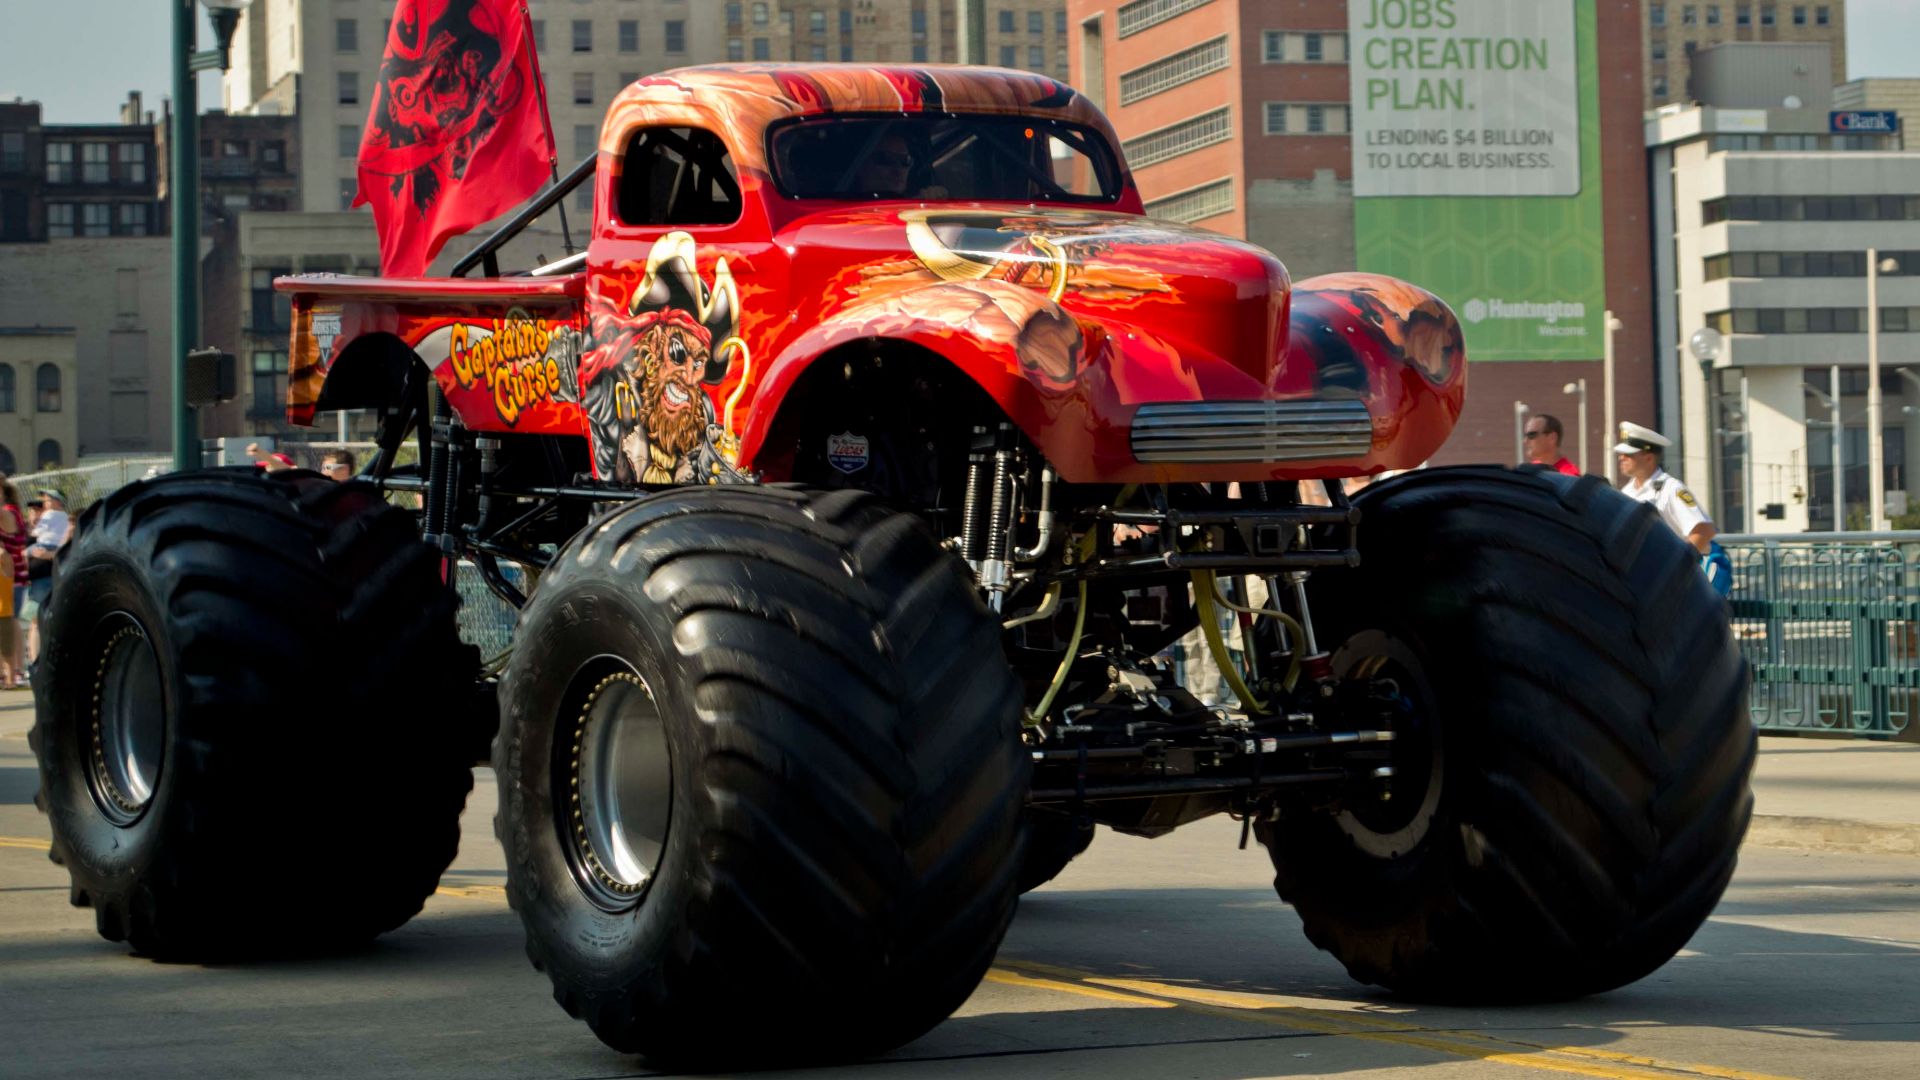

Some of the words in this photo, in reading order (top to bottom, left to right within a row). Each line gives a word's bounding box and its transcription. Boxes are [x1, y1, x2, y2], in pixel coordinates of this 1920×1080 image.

[1363, 0, 1457, 29] JOBS
[1364, 38, 1549, 70] CREATION
[1366, 78, 1476, 111] PLAN.
[1366, 129, 1448, 146] LENDING
[1454, 129, 1476, 147] $4
[1484, 129, 1554, 146] BILLION
[1368, 152, 1391, 169] TO
[1397, 152, 1454, 169] LOCAL
[1460, 152, 1556, 169] BUSINESS.
[1489, 298, 1585, 324] Huntington
[493, 357, 561, 428] Curse
